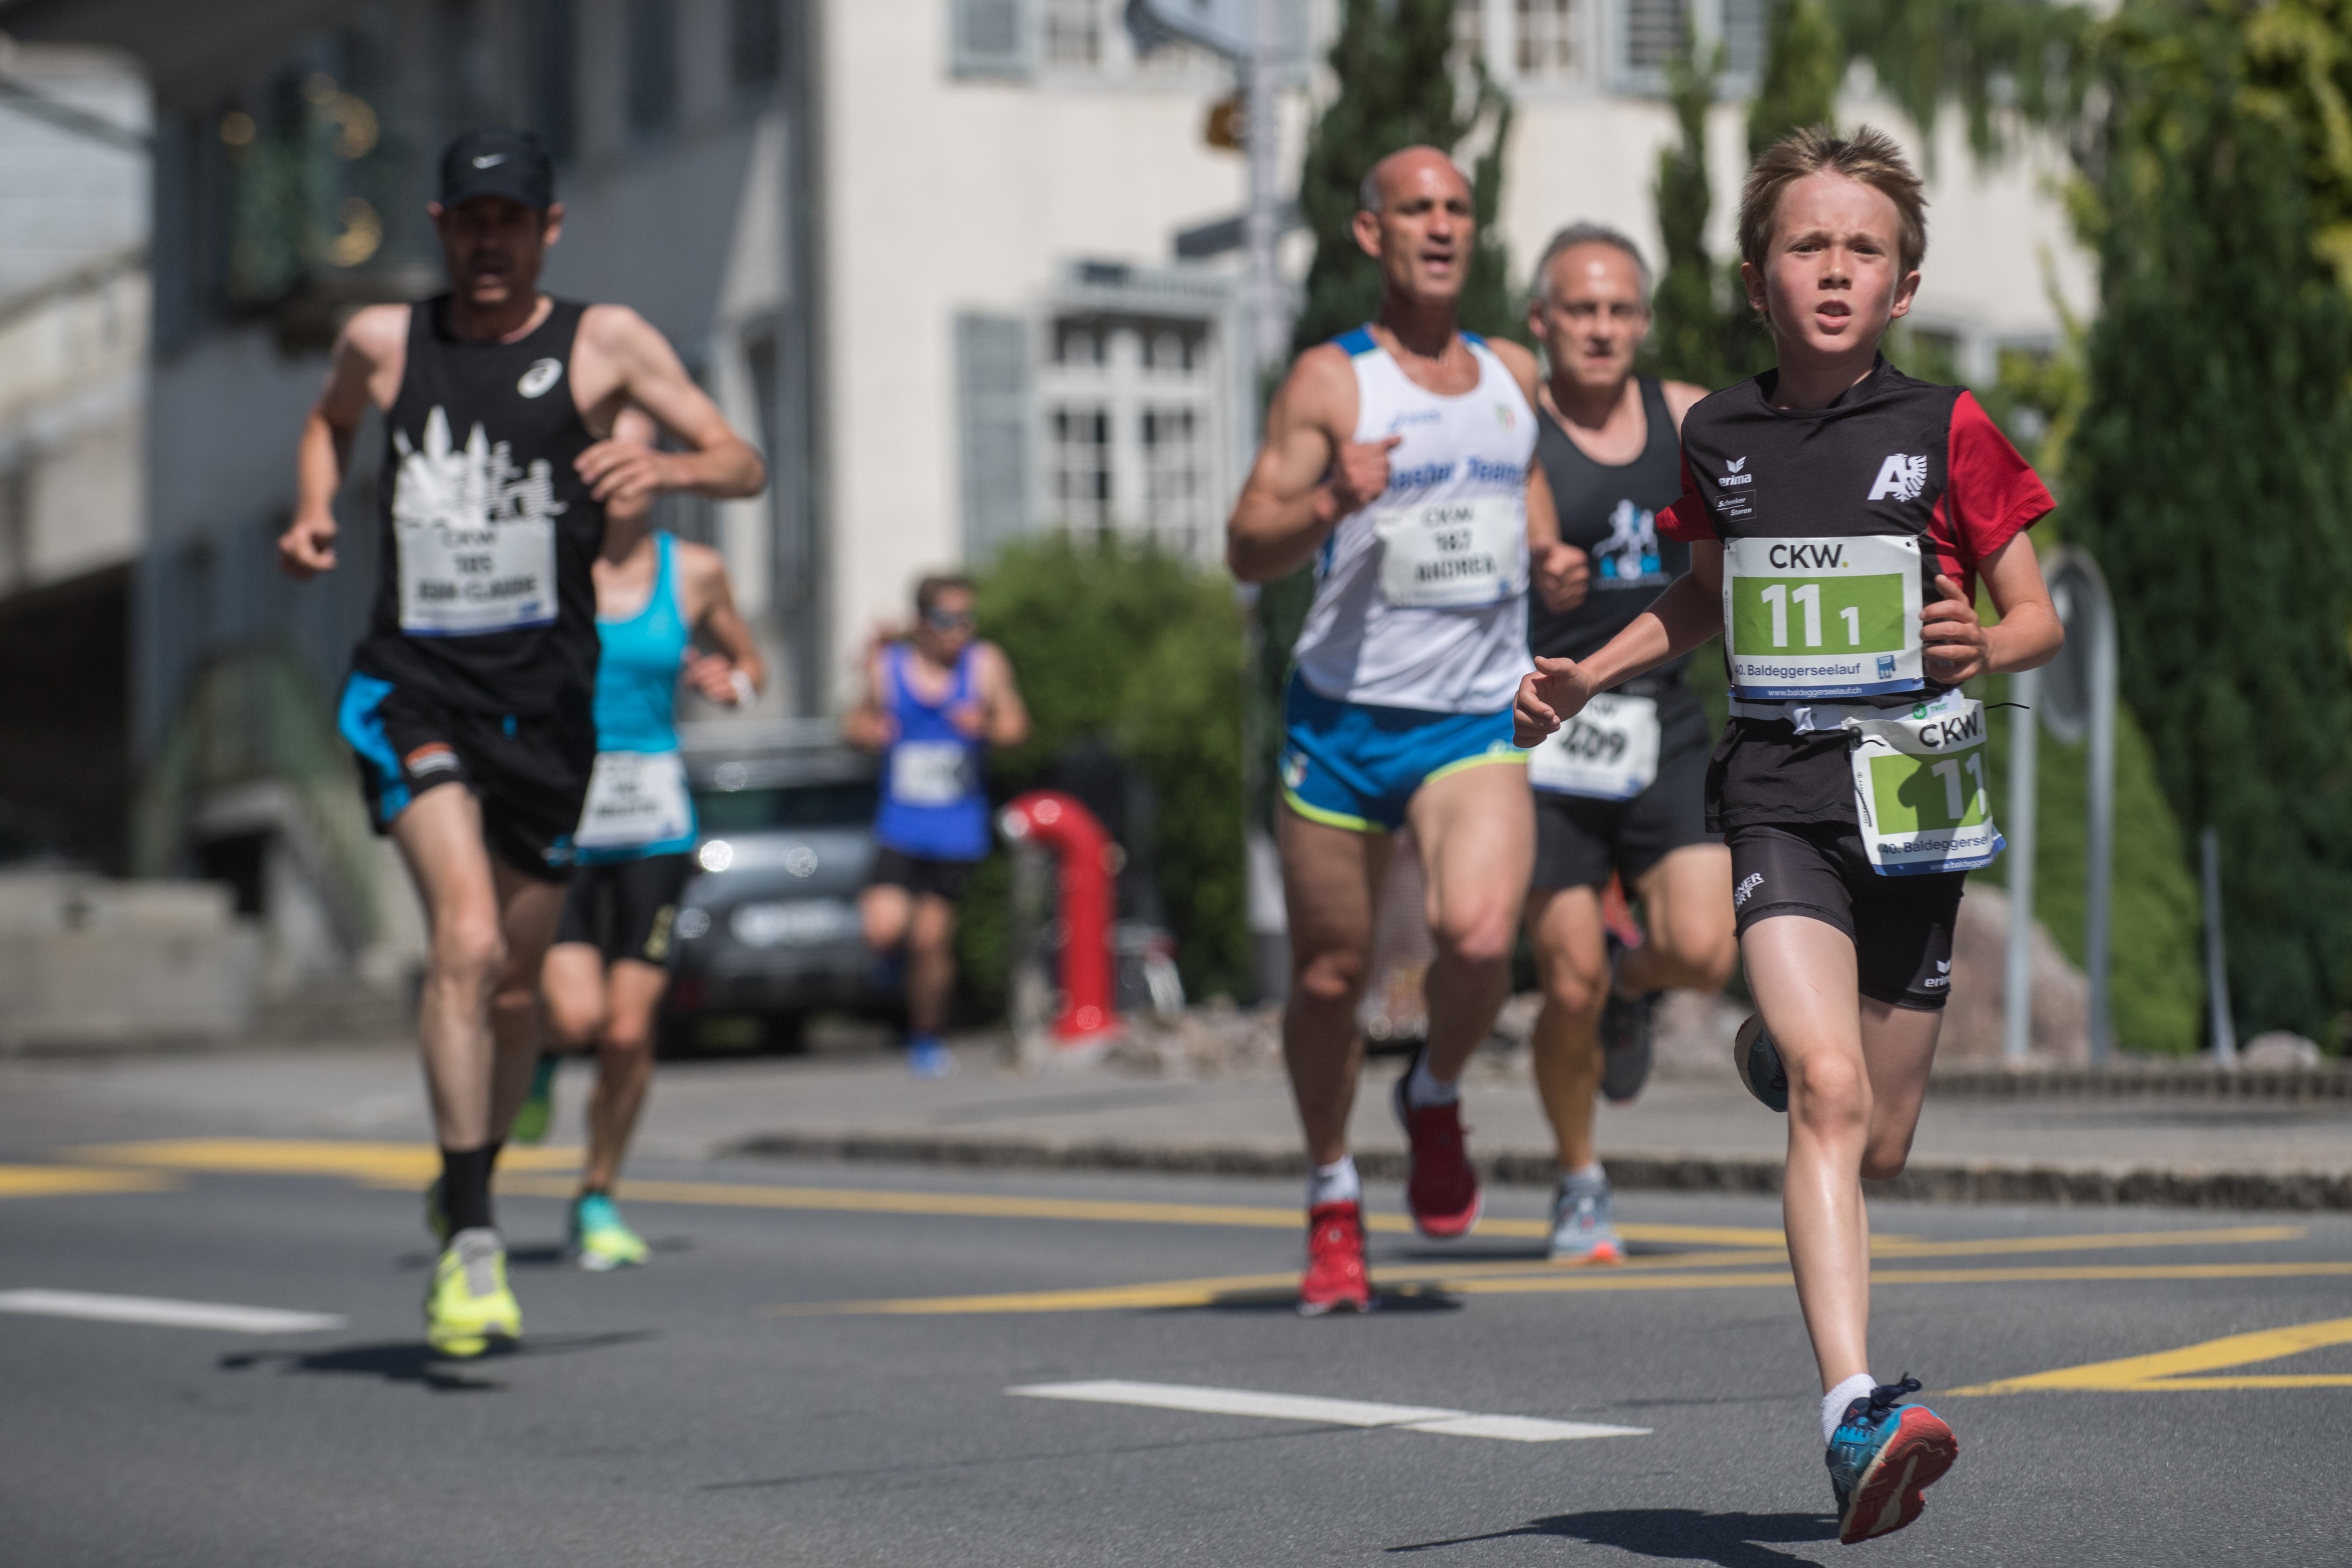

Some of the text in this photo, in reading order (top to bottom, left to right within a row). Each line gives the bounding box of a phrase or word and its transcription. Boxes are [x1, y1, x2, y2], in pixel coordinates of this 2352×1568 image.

[1718, 474, 1752, 487] erima
[1718, 498, 1746, 507] Schenker
[1761, 584, 1822, 647] 11
[1839, 606, 1860, 645] 1
[1748, 663, 1861, 678] Baldeggerseelauf
[1768, 687, 1862, 697] www.baldeggerseelauf.ch
[1931, 752, 1986, 819] 11
[1882, 843, 1901, 855] 40.
